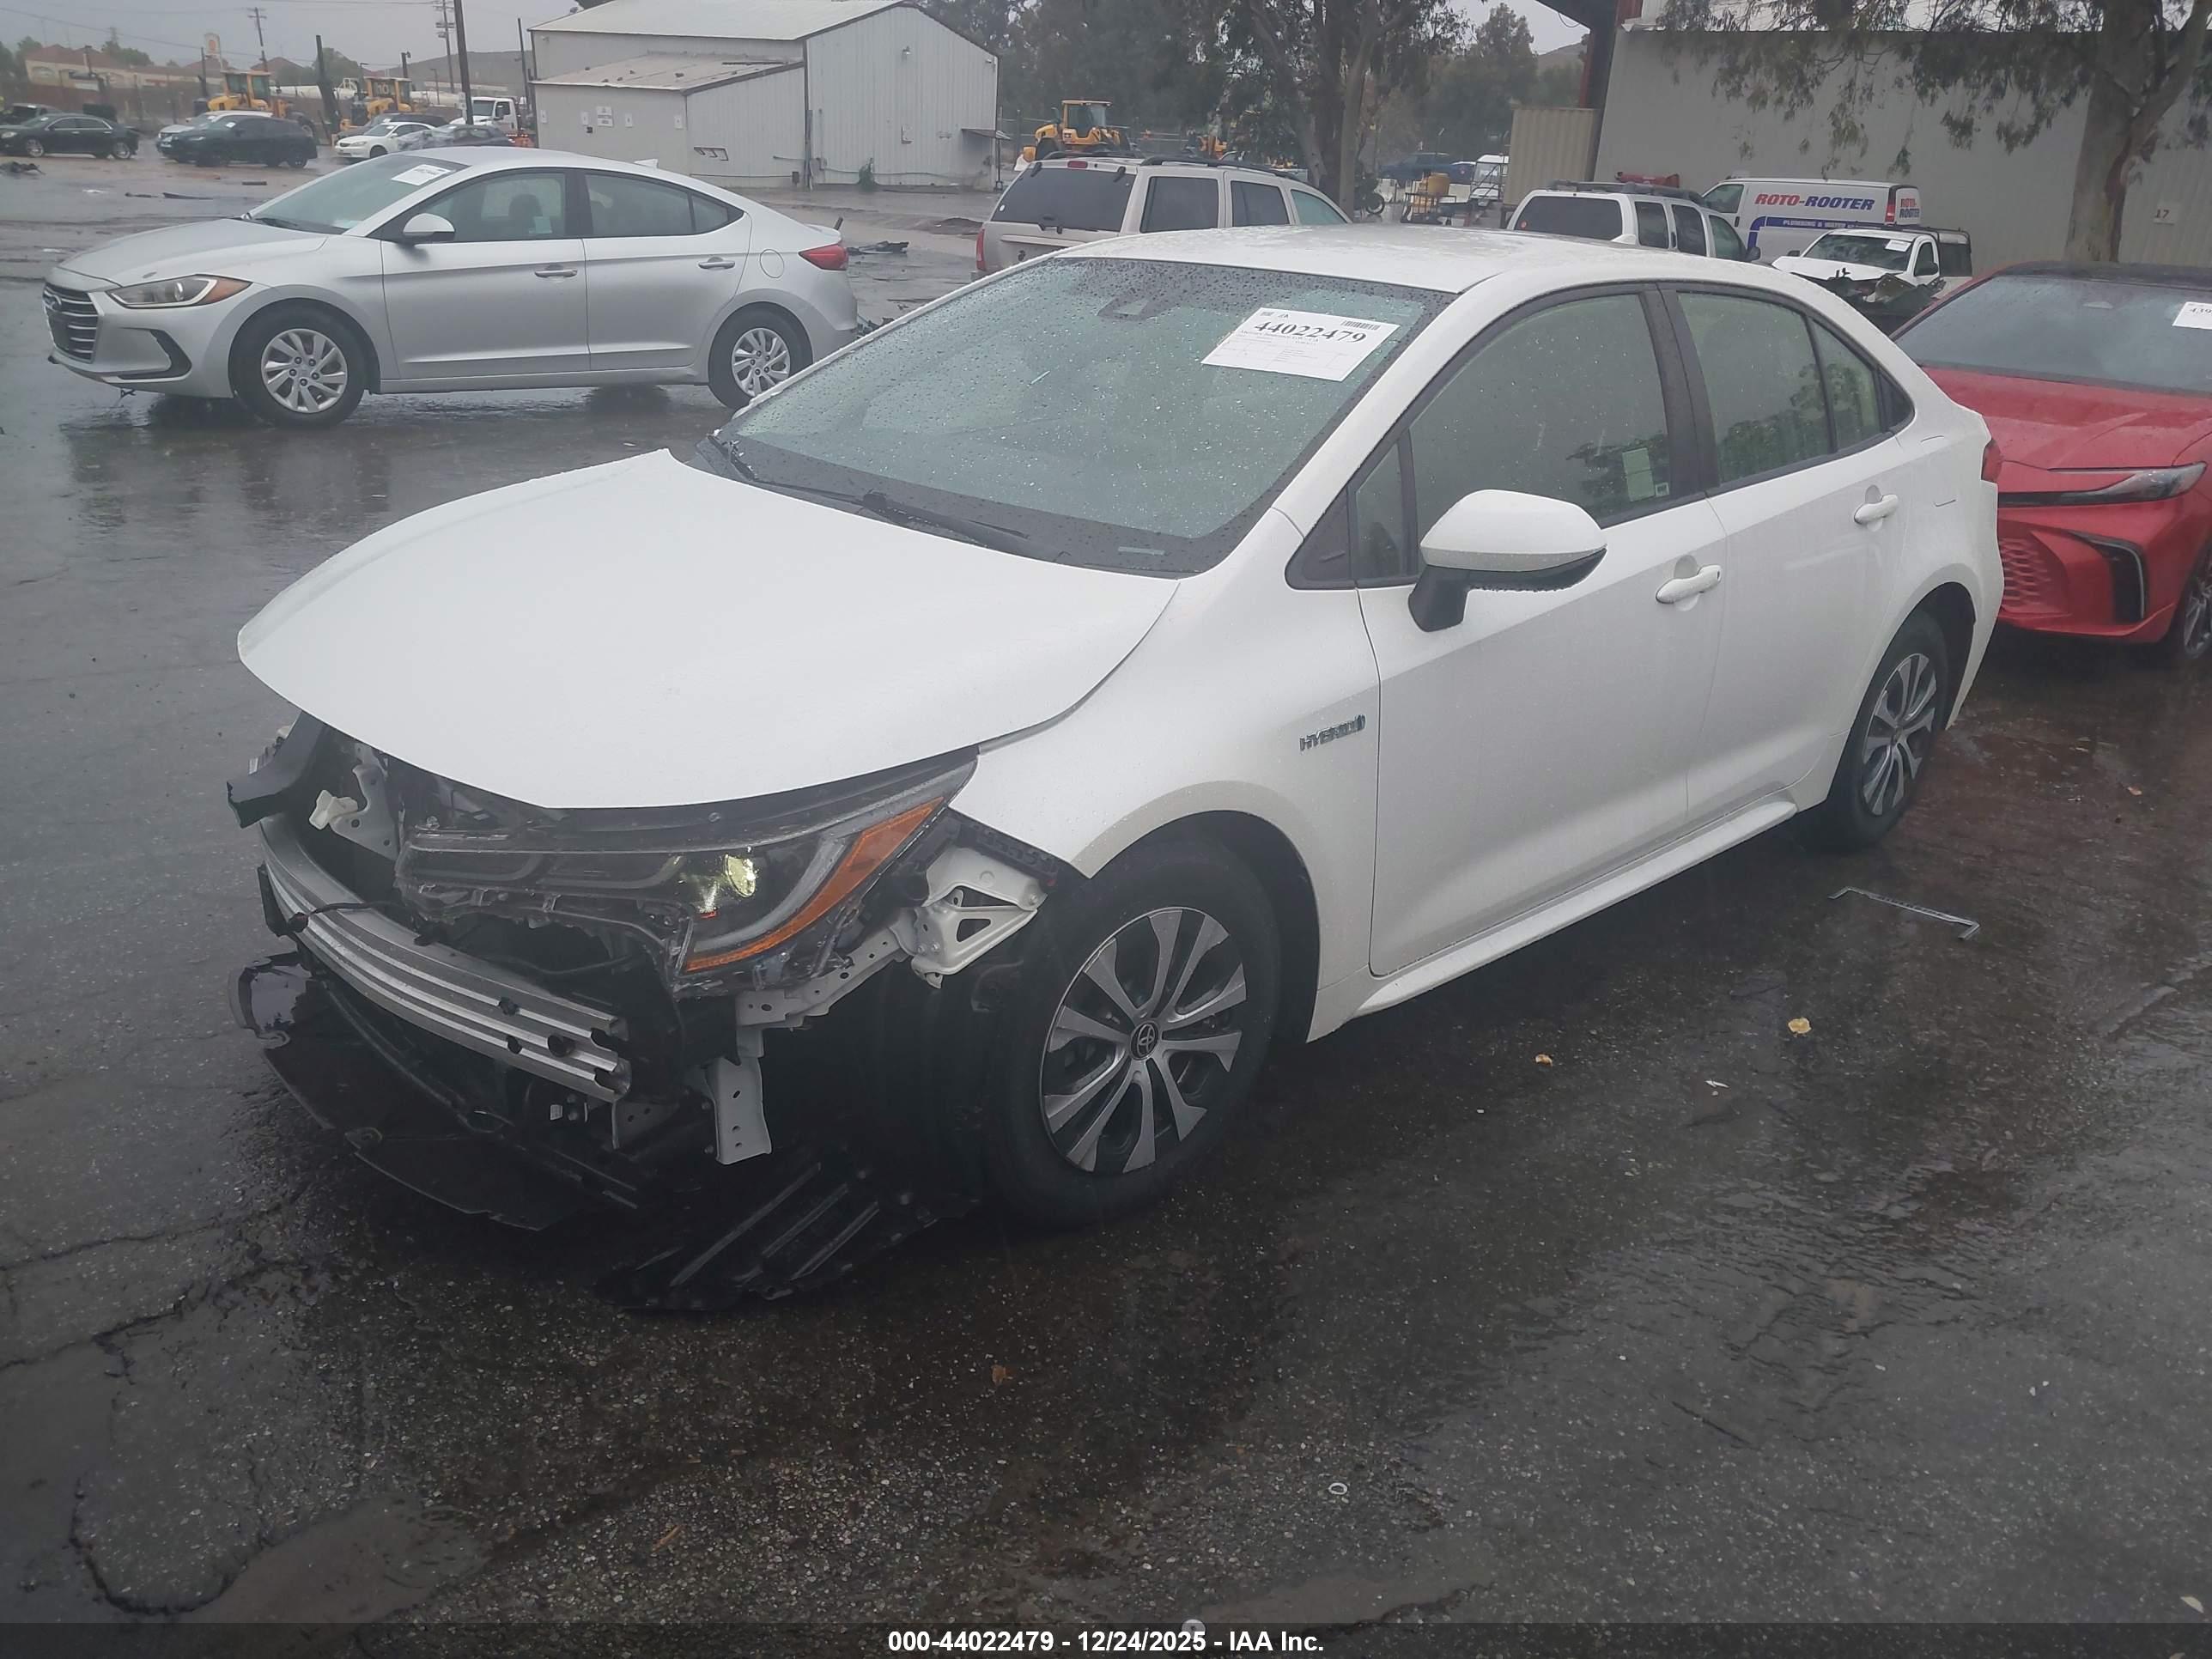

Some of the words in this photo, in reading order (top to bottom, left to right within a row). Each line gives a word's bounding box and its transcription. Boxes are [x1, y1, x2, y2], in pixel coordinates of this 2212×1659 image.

[1754, 193, 1875, 210] ROTO-ROOTER
[2155, 210, 2170, 218] 17
[1255, 321, 1367, 343] 44022479
